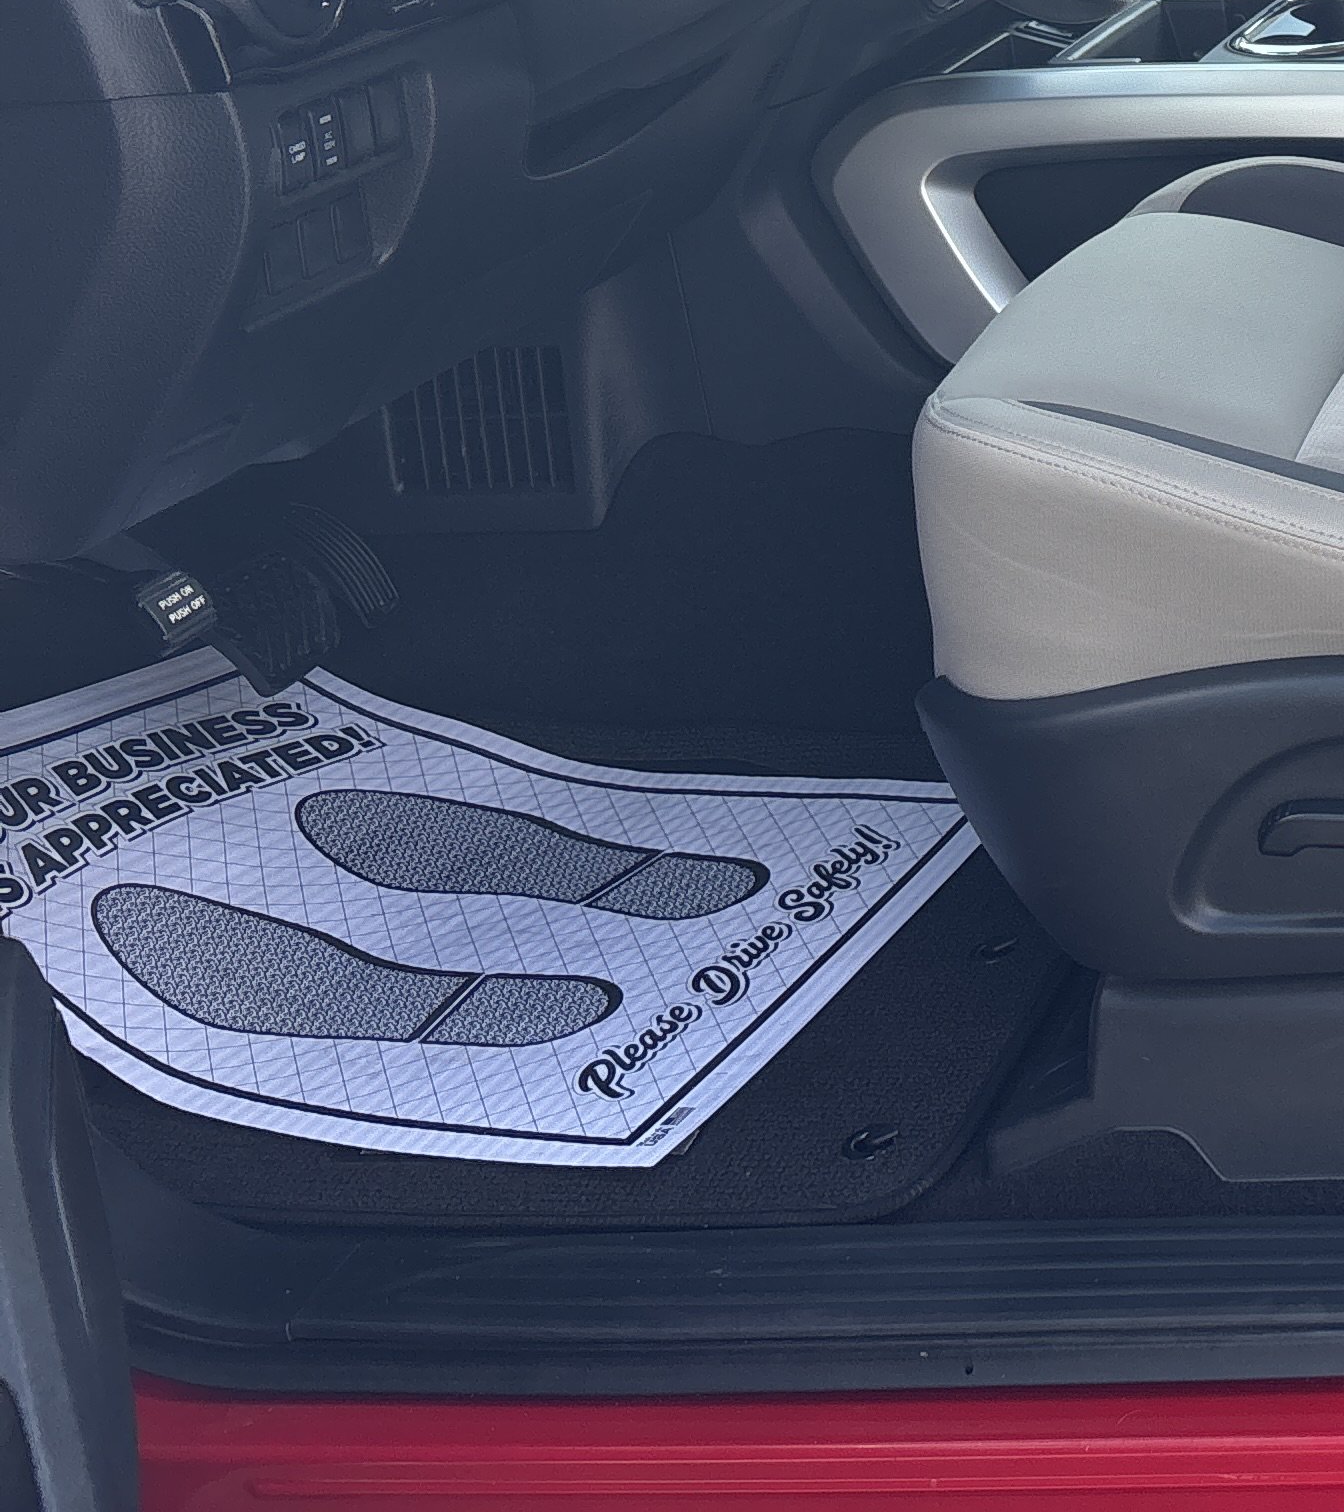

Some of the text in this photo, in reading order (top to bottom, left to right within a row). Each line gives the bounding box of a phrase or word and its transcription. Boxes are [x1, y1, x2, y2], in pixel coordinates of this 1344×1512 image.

[158, 584, 195, 611] PUSH ON
[168, 594, 206, 624] PUSH OFF
[0, 702, 311, 829] UR BUSINESS
[20, 725, 376, 887] APPRECIATED!
[578, 824, 894, 1099] Please Drive Safely!
